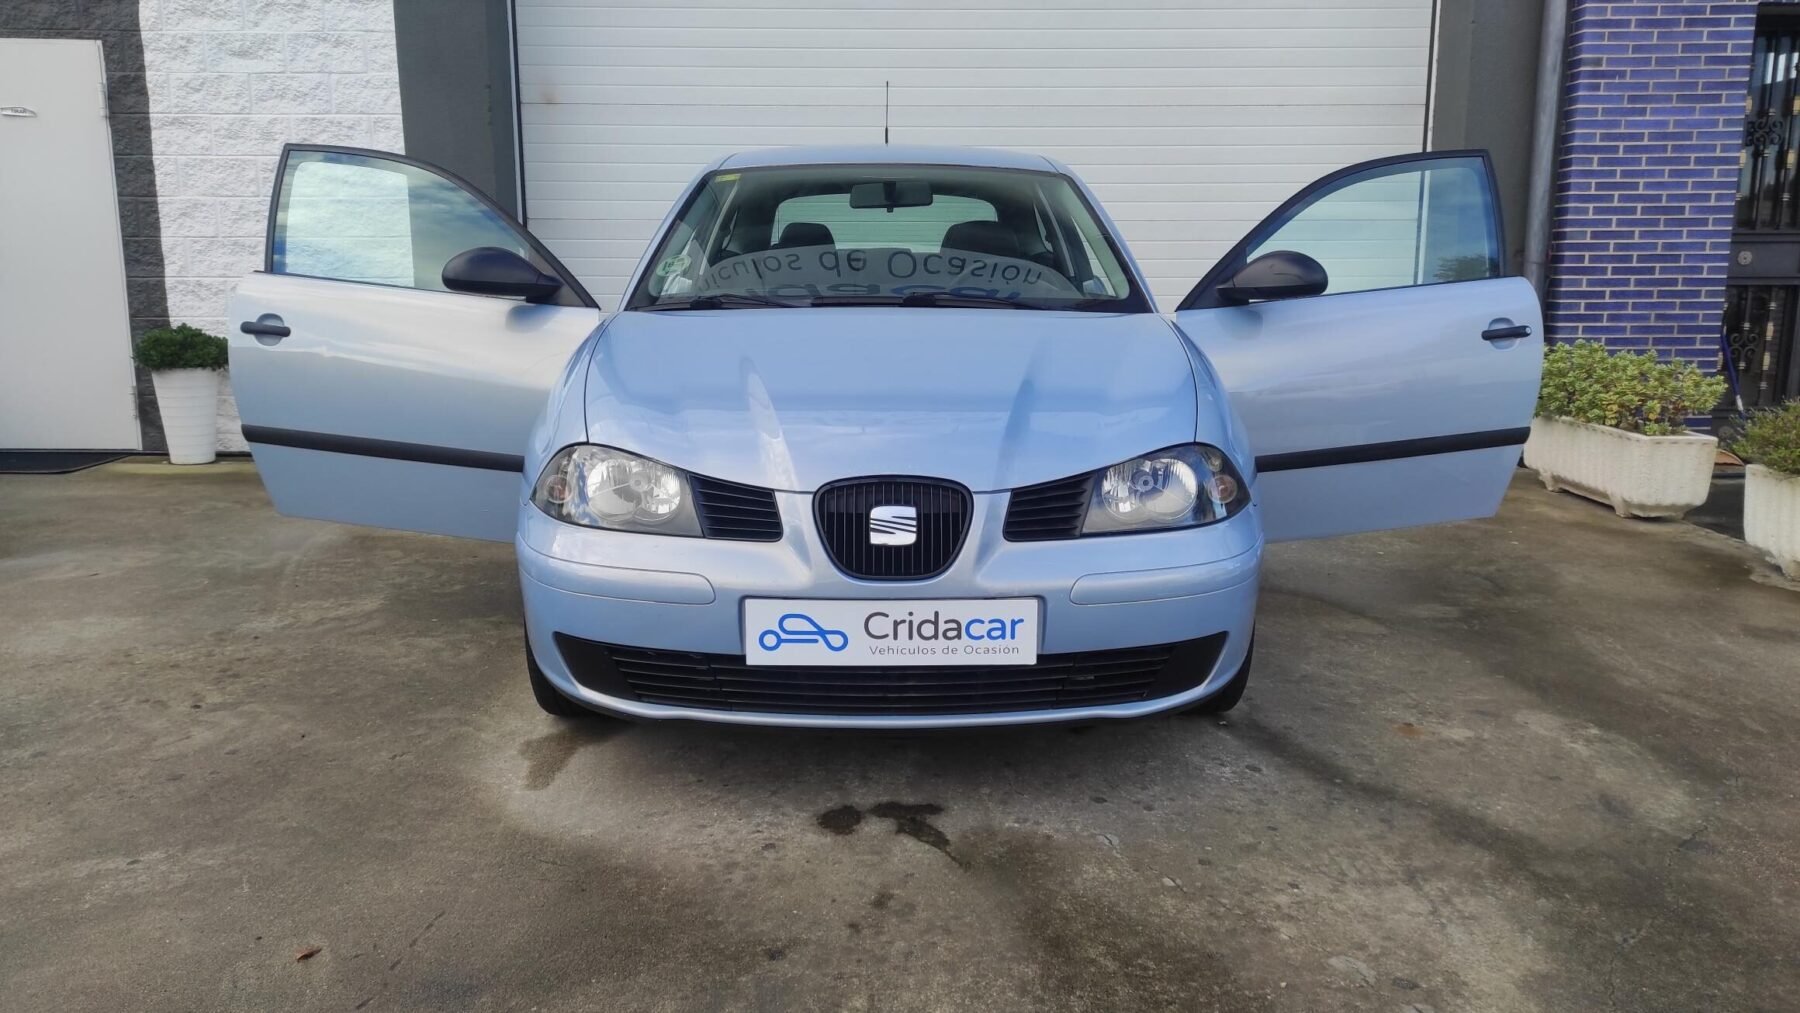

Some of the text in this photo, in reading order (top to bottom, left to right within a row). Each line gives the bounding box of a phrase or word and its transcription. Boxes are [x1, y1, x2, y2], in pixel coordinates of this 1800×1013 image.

[863, 610, 1025, 641] Cridacar
[869, 644, 1020, 656] Vehículos de Ocasión
